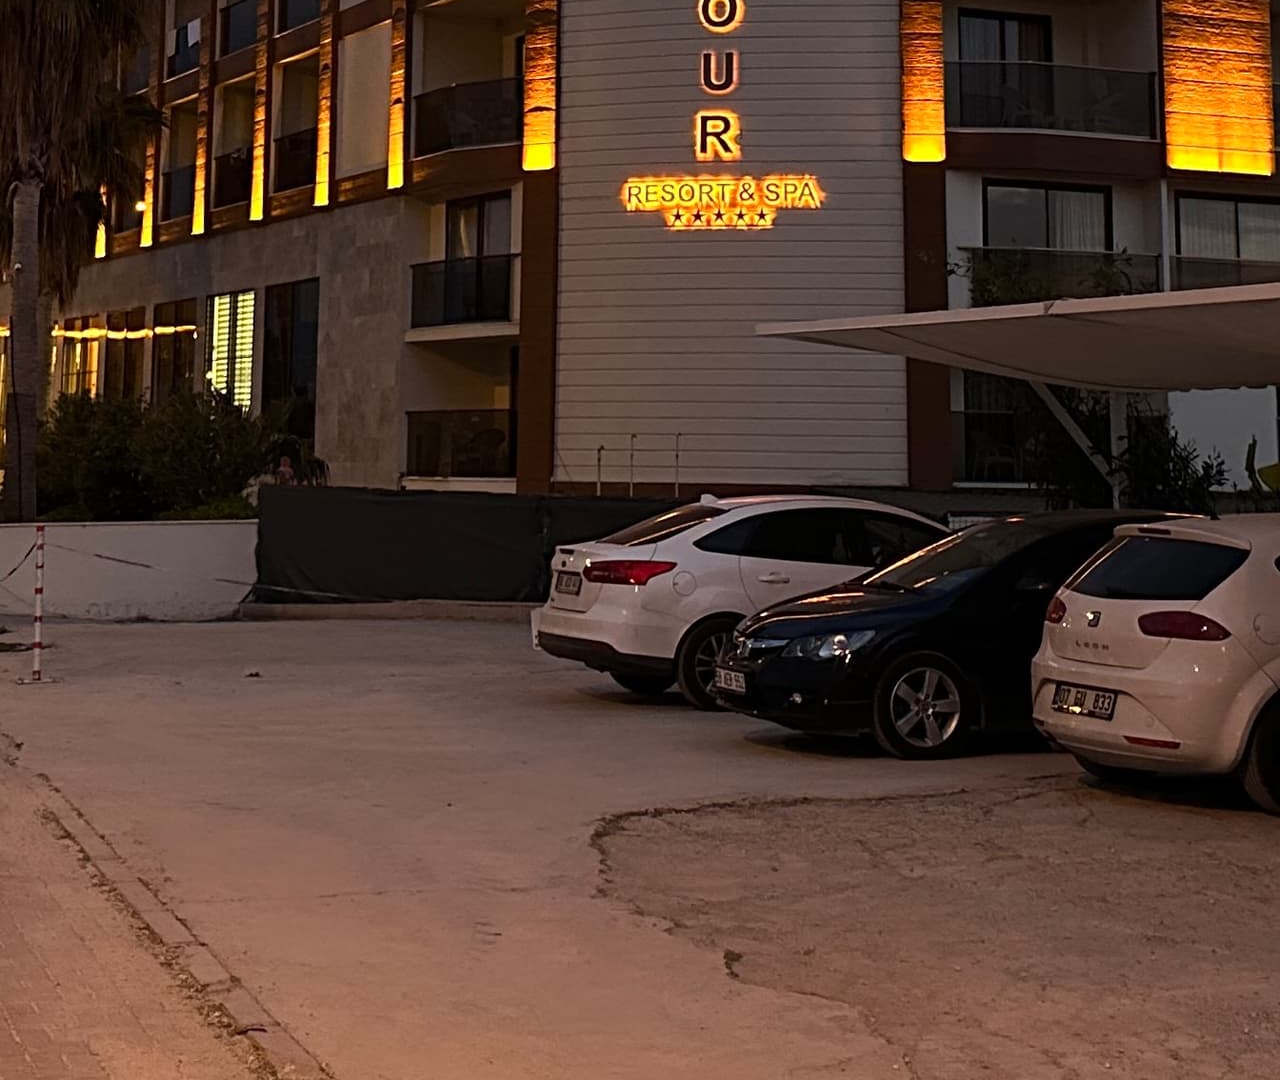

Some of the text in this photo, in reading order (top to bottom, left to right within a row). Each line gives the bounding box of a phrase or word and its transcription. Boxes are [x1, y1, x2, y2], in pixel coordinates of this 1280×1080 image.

[627, 181, 817, 204] RESORT & SPA
[1092, 693, 1113, 711] 833
